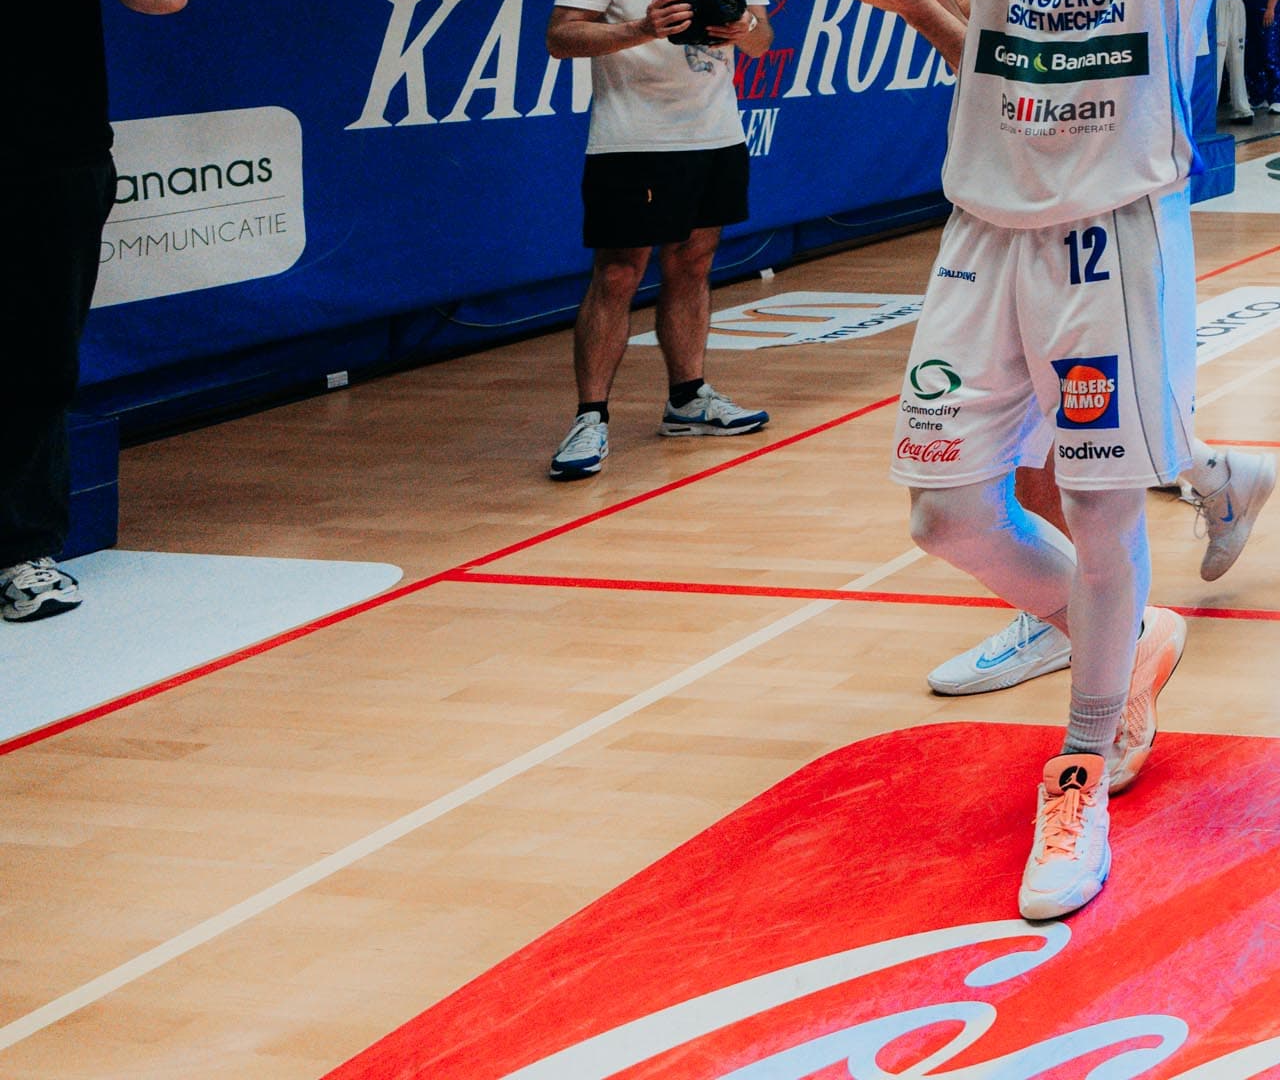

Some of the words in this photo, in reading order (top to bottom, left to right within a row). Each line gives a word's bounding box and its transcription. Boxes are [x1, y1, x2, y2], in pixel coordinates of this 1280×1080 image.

[1051, 48, 1133, 71] Bananas
[1001, 93, 1116, 123] Pellikaan
[1069, 122, 1116, 135] OPERATE
[1063, 226, 1111, 286] 12
[937, 266, 977, 283] SPALDING
[901, 400, 962, 419] Commodity
[1064, 394, 1105, 411] IMMO
[908, 417, 943, 432] Centre
[1058, 441, 1126, 460] sodiwe
